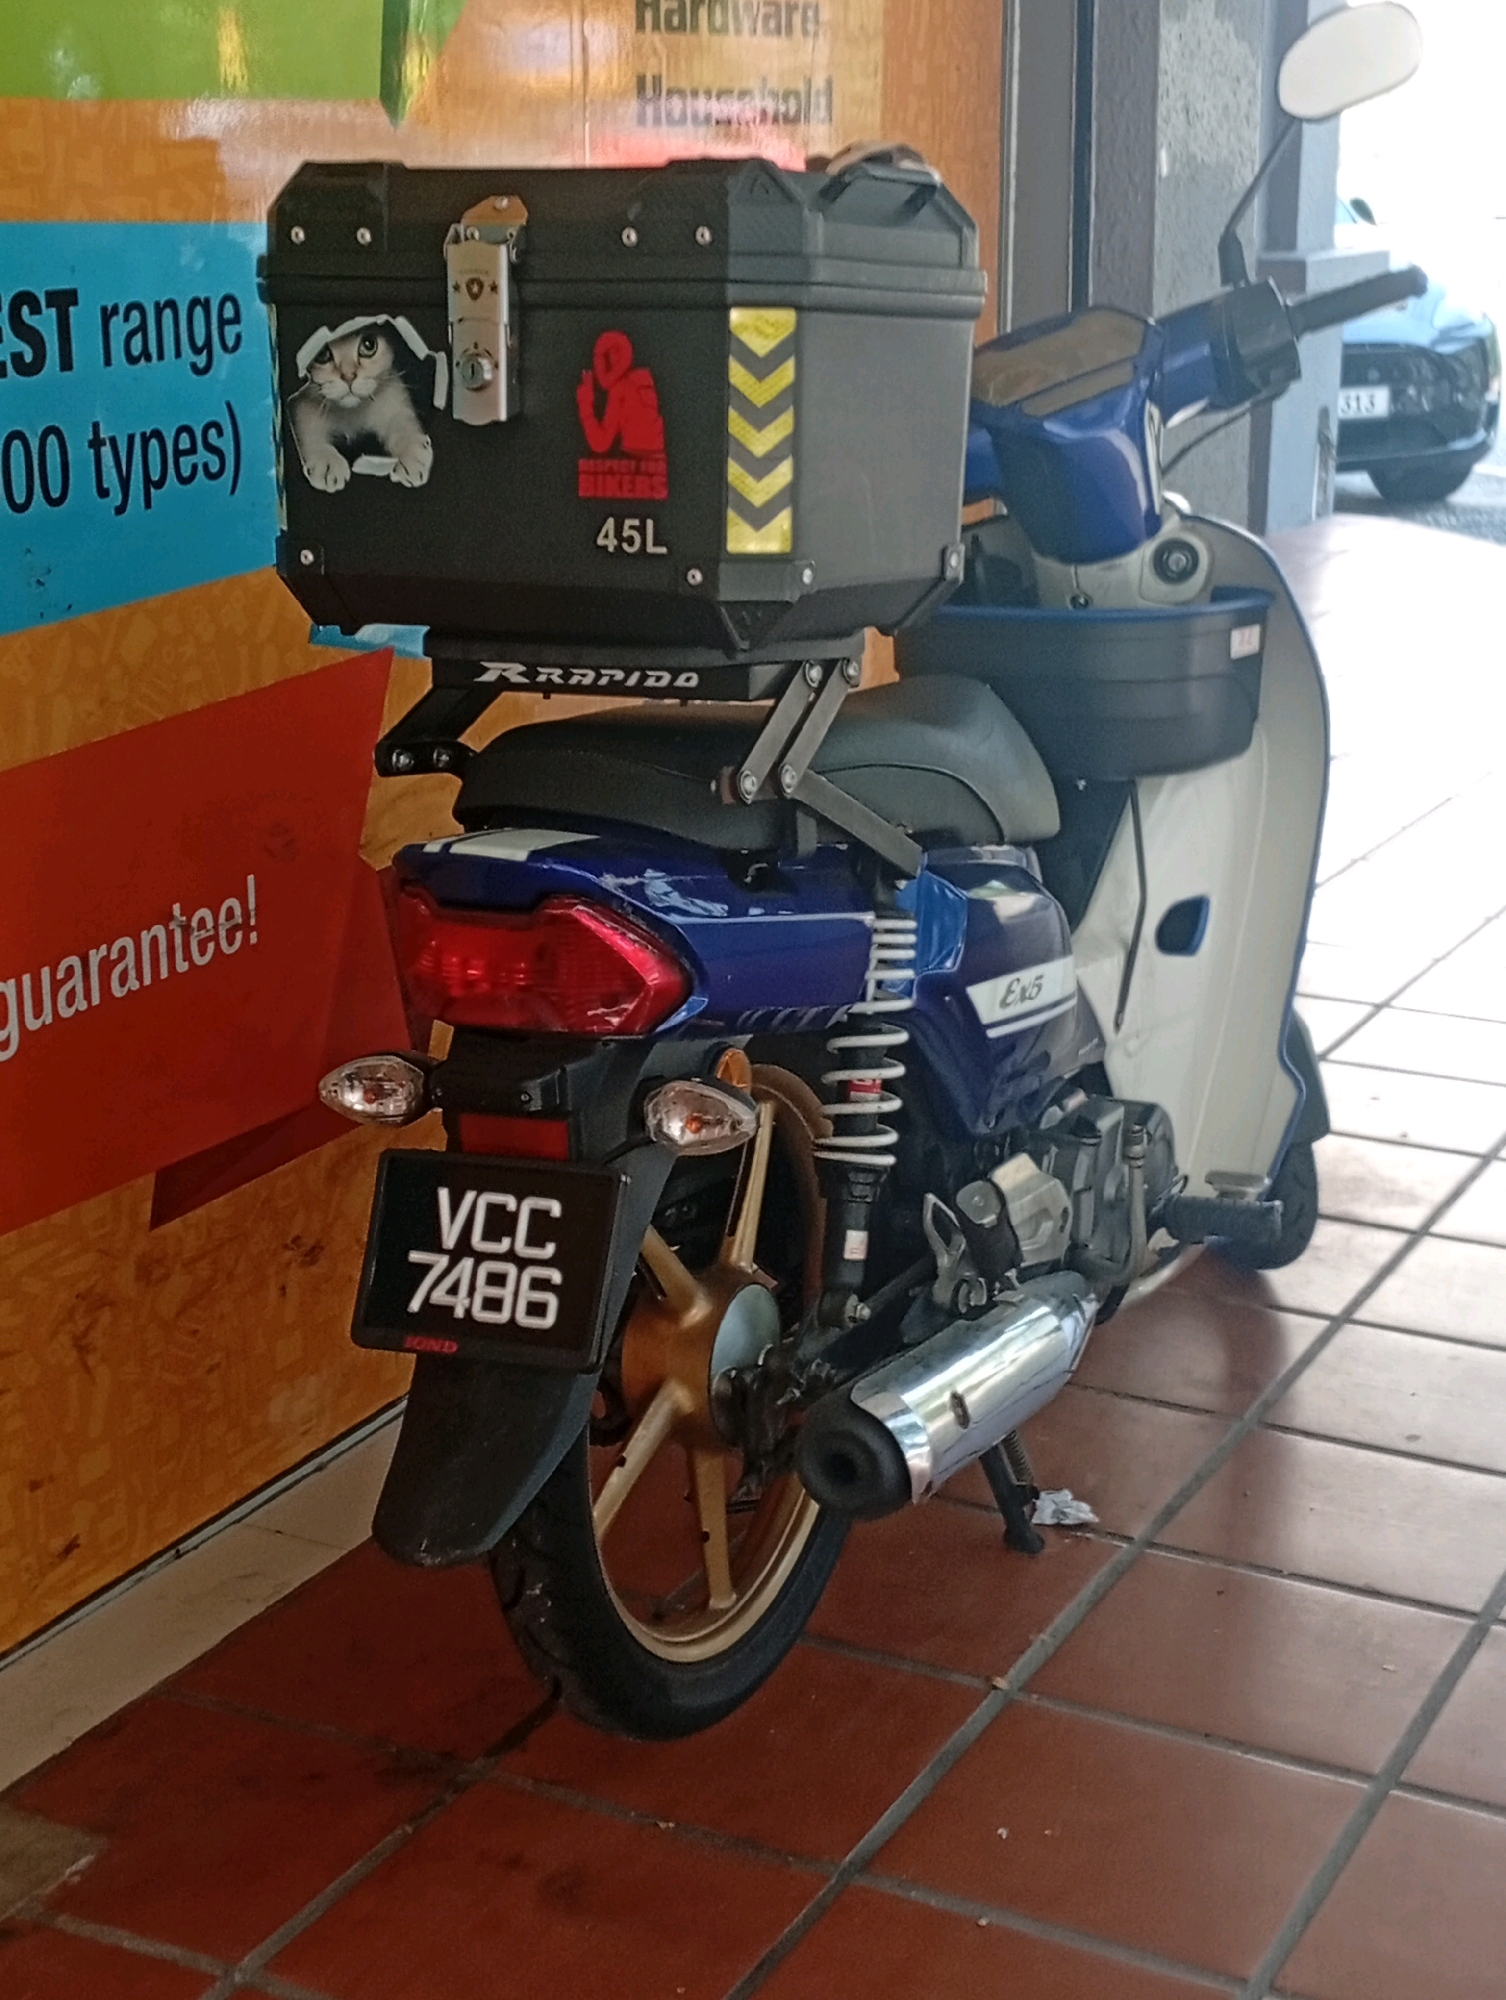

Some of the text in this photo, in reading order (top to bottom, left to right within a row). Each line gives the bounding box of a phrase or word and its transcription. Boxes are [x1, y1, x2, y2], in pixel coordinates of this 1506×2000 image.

[635, 0, 819, 37] Hardware
[636, 74, 833, 126] Household
[0, 287, 242, 379] ST range
[1, 400, 241, 516] 00 types)
[596, 516, 668, 554] 45L
[535, 666, 699, 688] RAPIDO
[0, 874, 258, 1062] guarantee!
[437, 1186, 562, 1260] VCC
[407, 1250, 563, 1329] 7486
